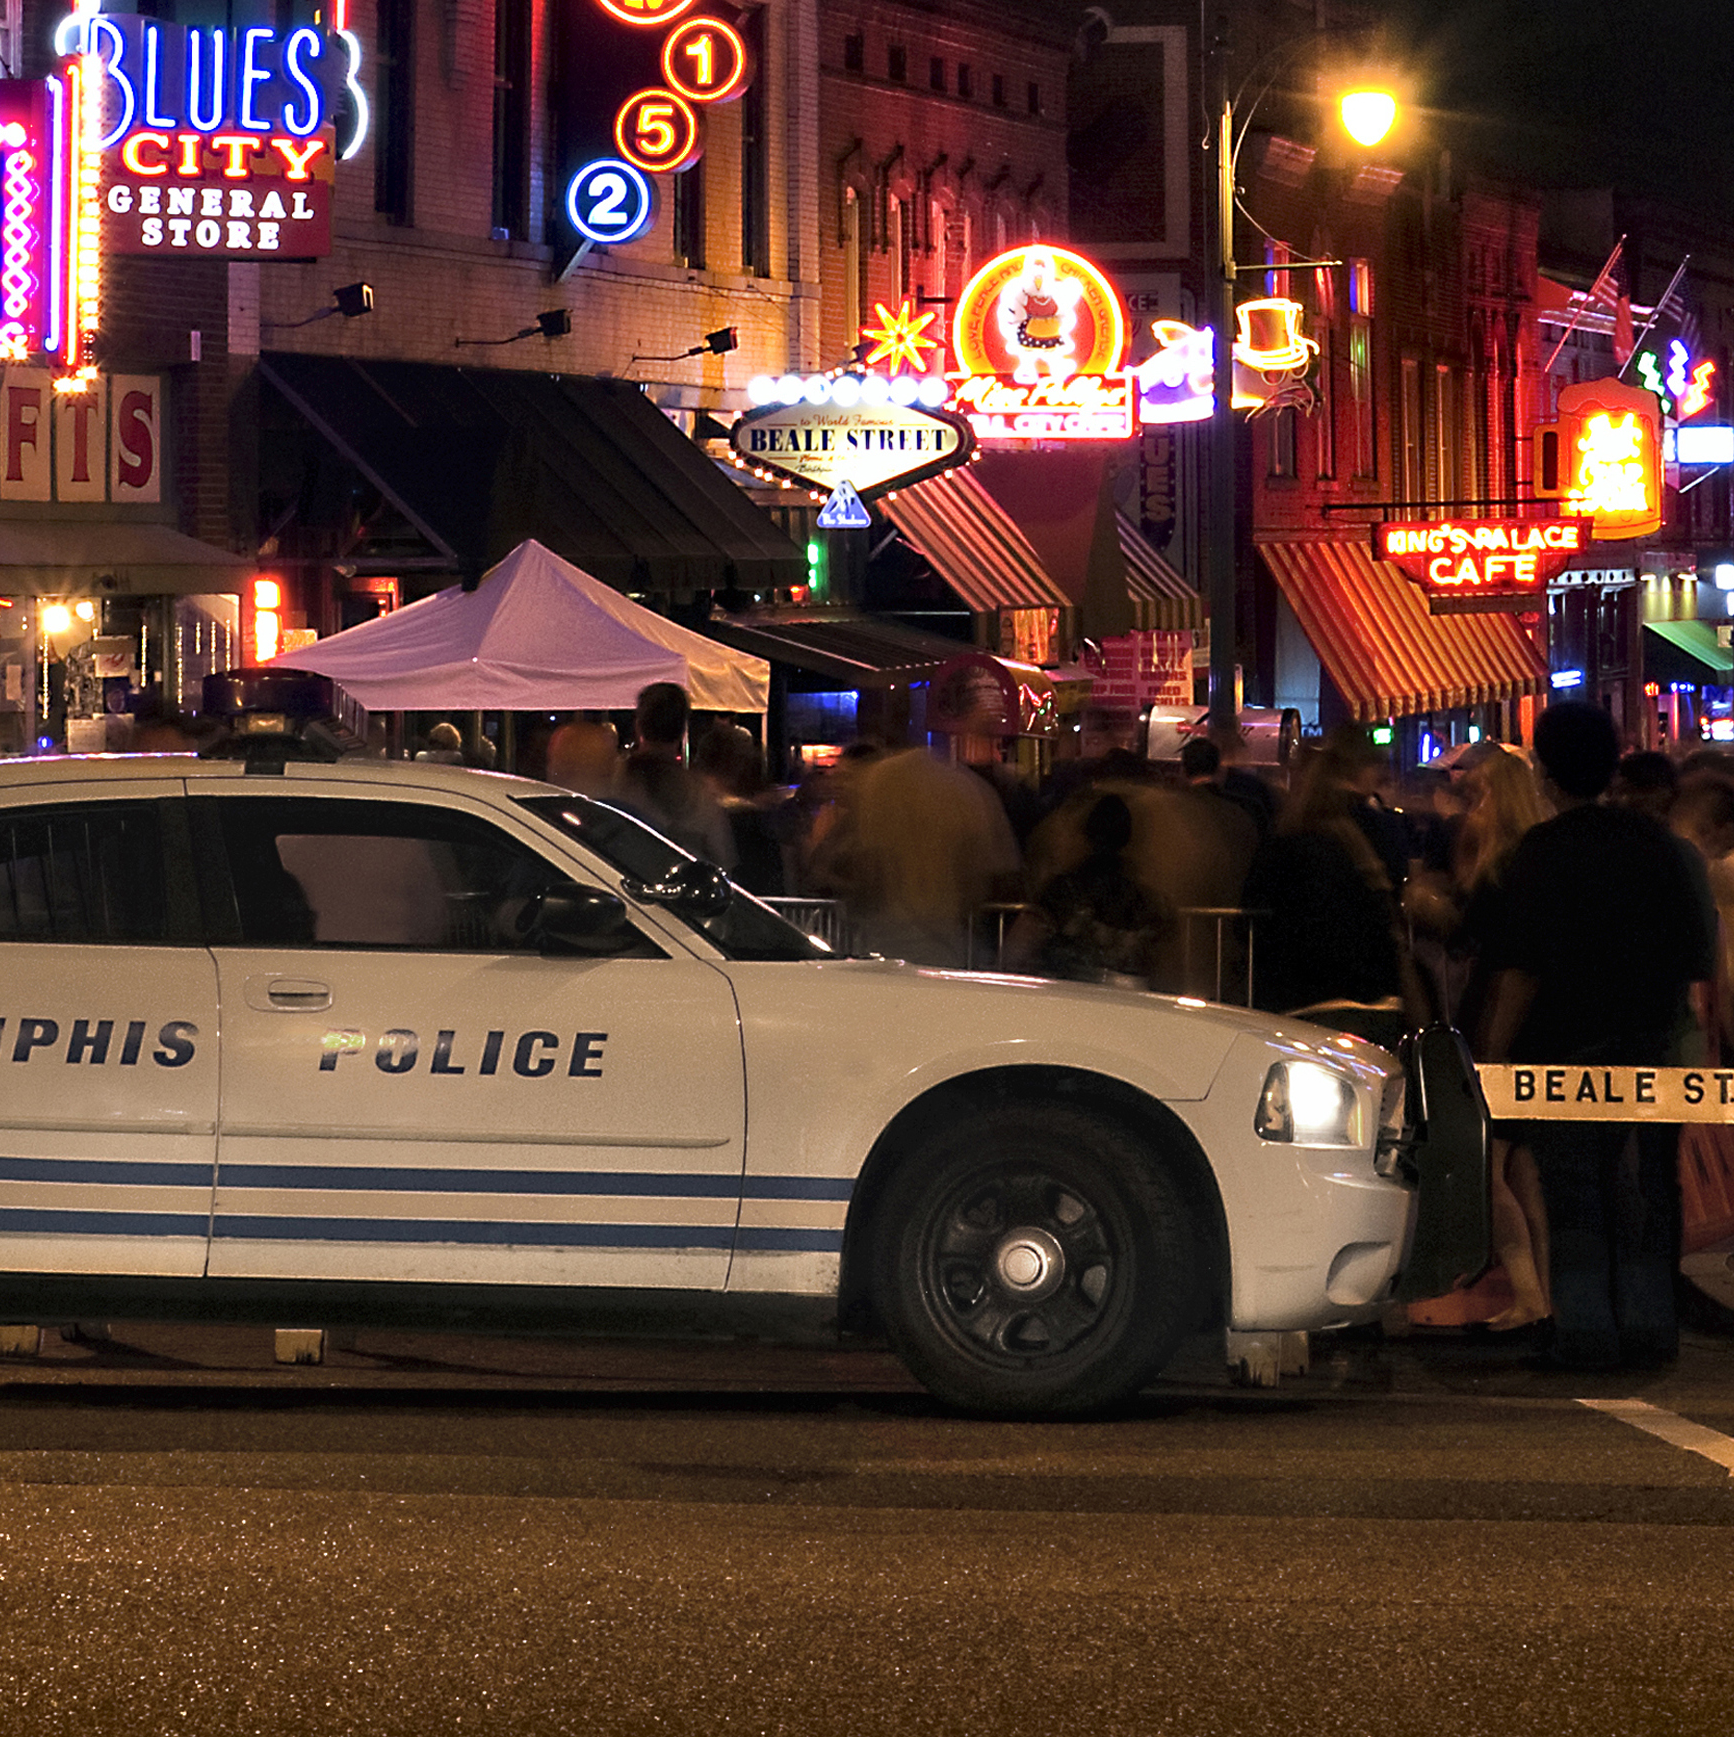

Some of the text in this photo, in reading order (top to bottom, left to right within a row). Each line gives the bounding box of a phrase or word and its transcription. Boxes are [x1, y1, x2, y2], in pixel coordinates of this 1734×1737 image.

[82, 16, 322, 150] BLUES
[587, 33, 713, 226] 1 5 2
[123, 131, 325, 180] CITY
[107, 184, 315, 220] GENERAL
[141, 217, 281, 250] STORE
[813, 414, 850, 426] World
[851, 414, 895, 427] Famous
[750, 429, 948, 452] BEALE STREET
[1386, 522, 1580, 555] KING'S PALACE
[1428, 554, 1538, 586] CAFE
[319, 1027, 609, 1079] POLICE
[1514, 1070, 1657, 1106] BEALE
